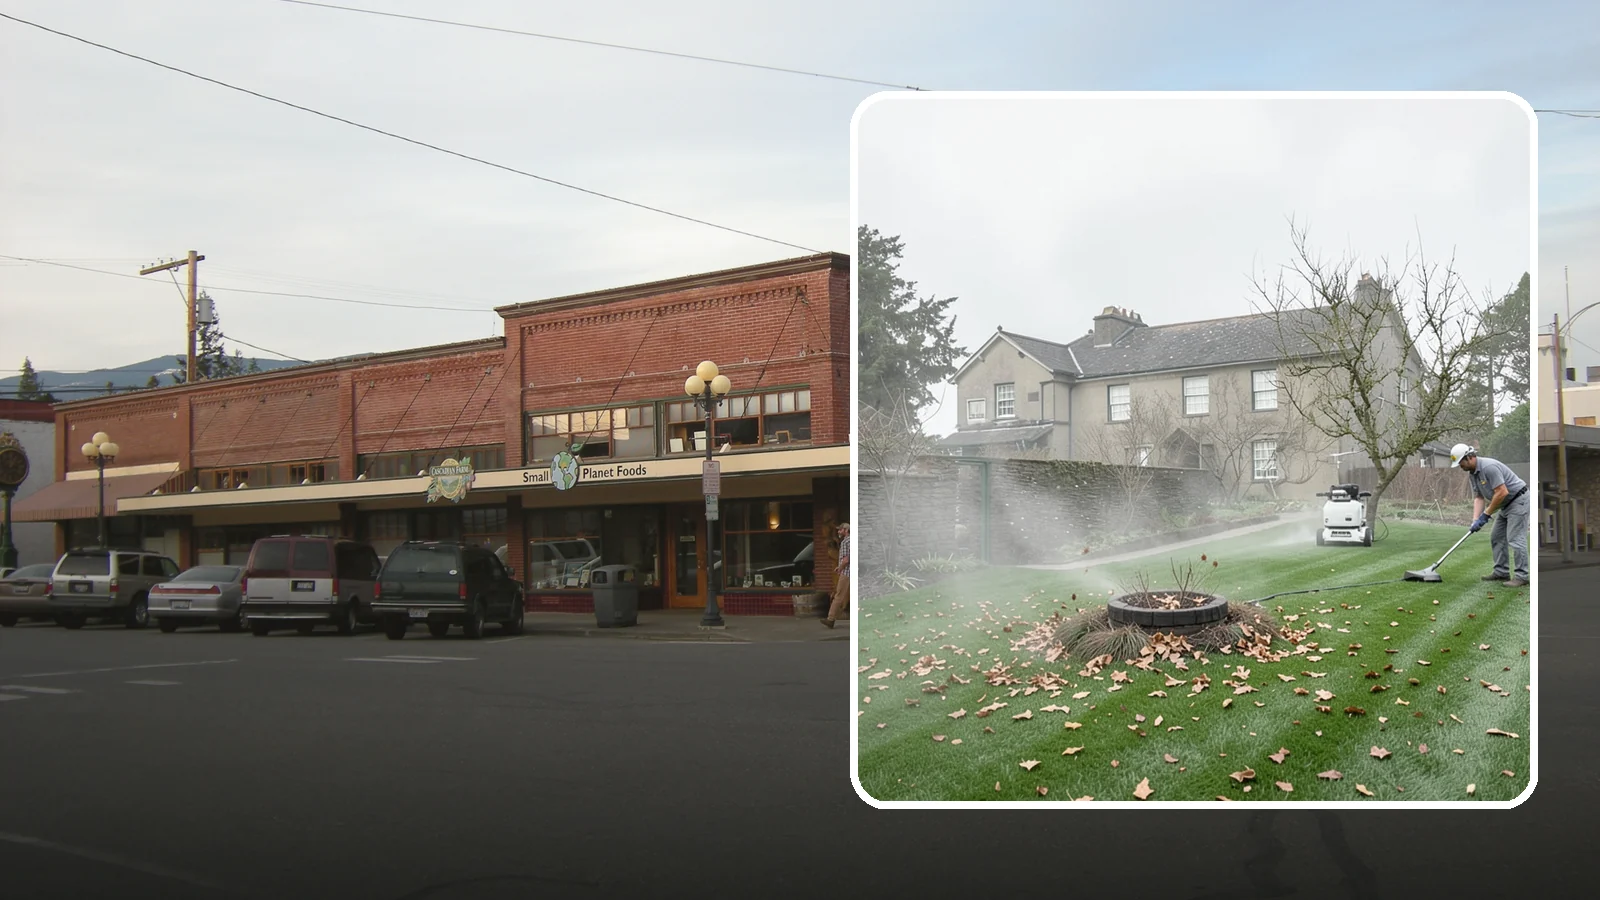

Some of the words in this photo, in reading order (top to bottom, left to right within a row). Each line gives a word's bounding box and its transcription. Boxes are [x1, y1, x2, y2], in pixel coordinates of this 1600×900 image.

[456, 466, 469, 474] FARM
[523, 471, 548, 482] Small
[583, 467, 613, 479] Planet
[617, 464, 646, 476] Foods
